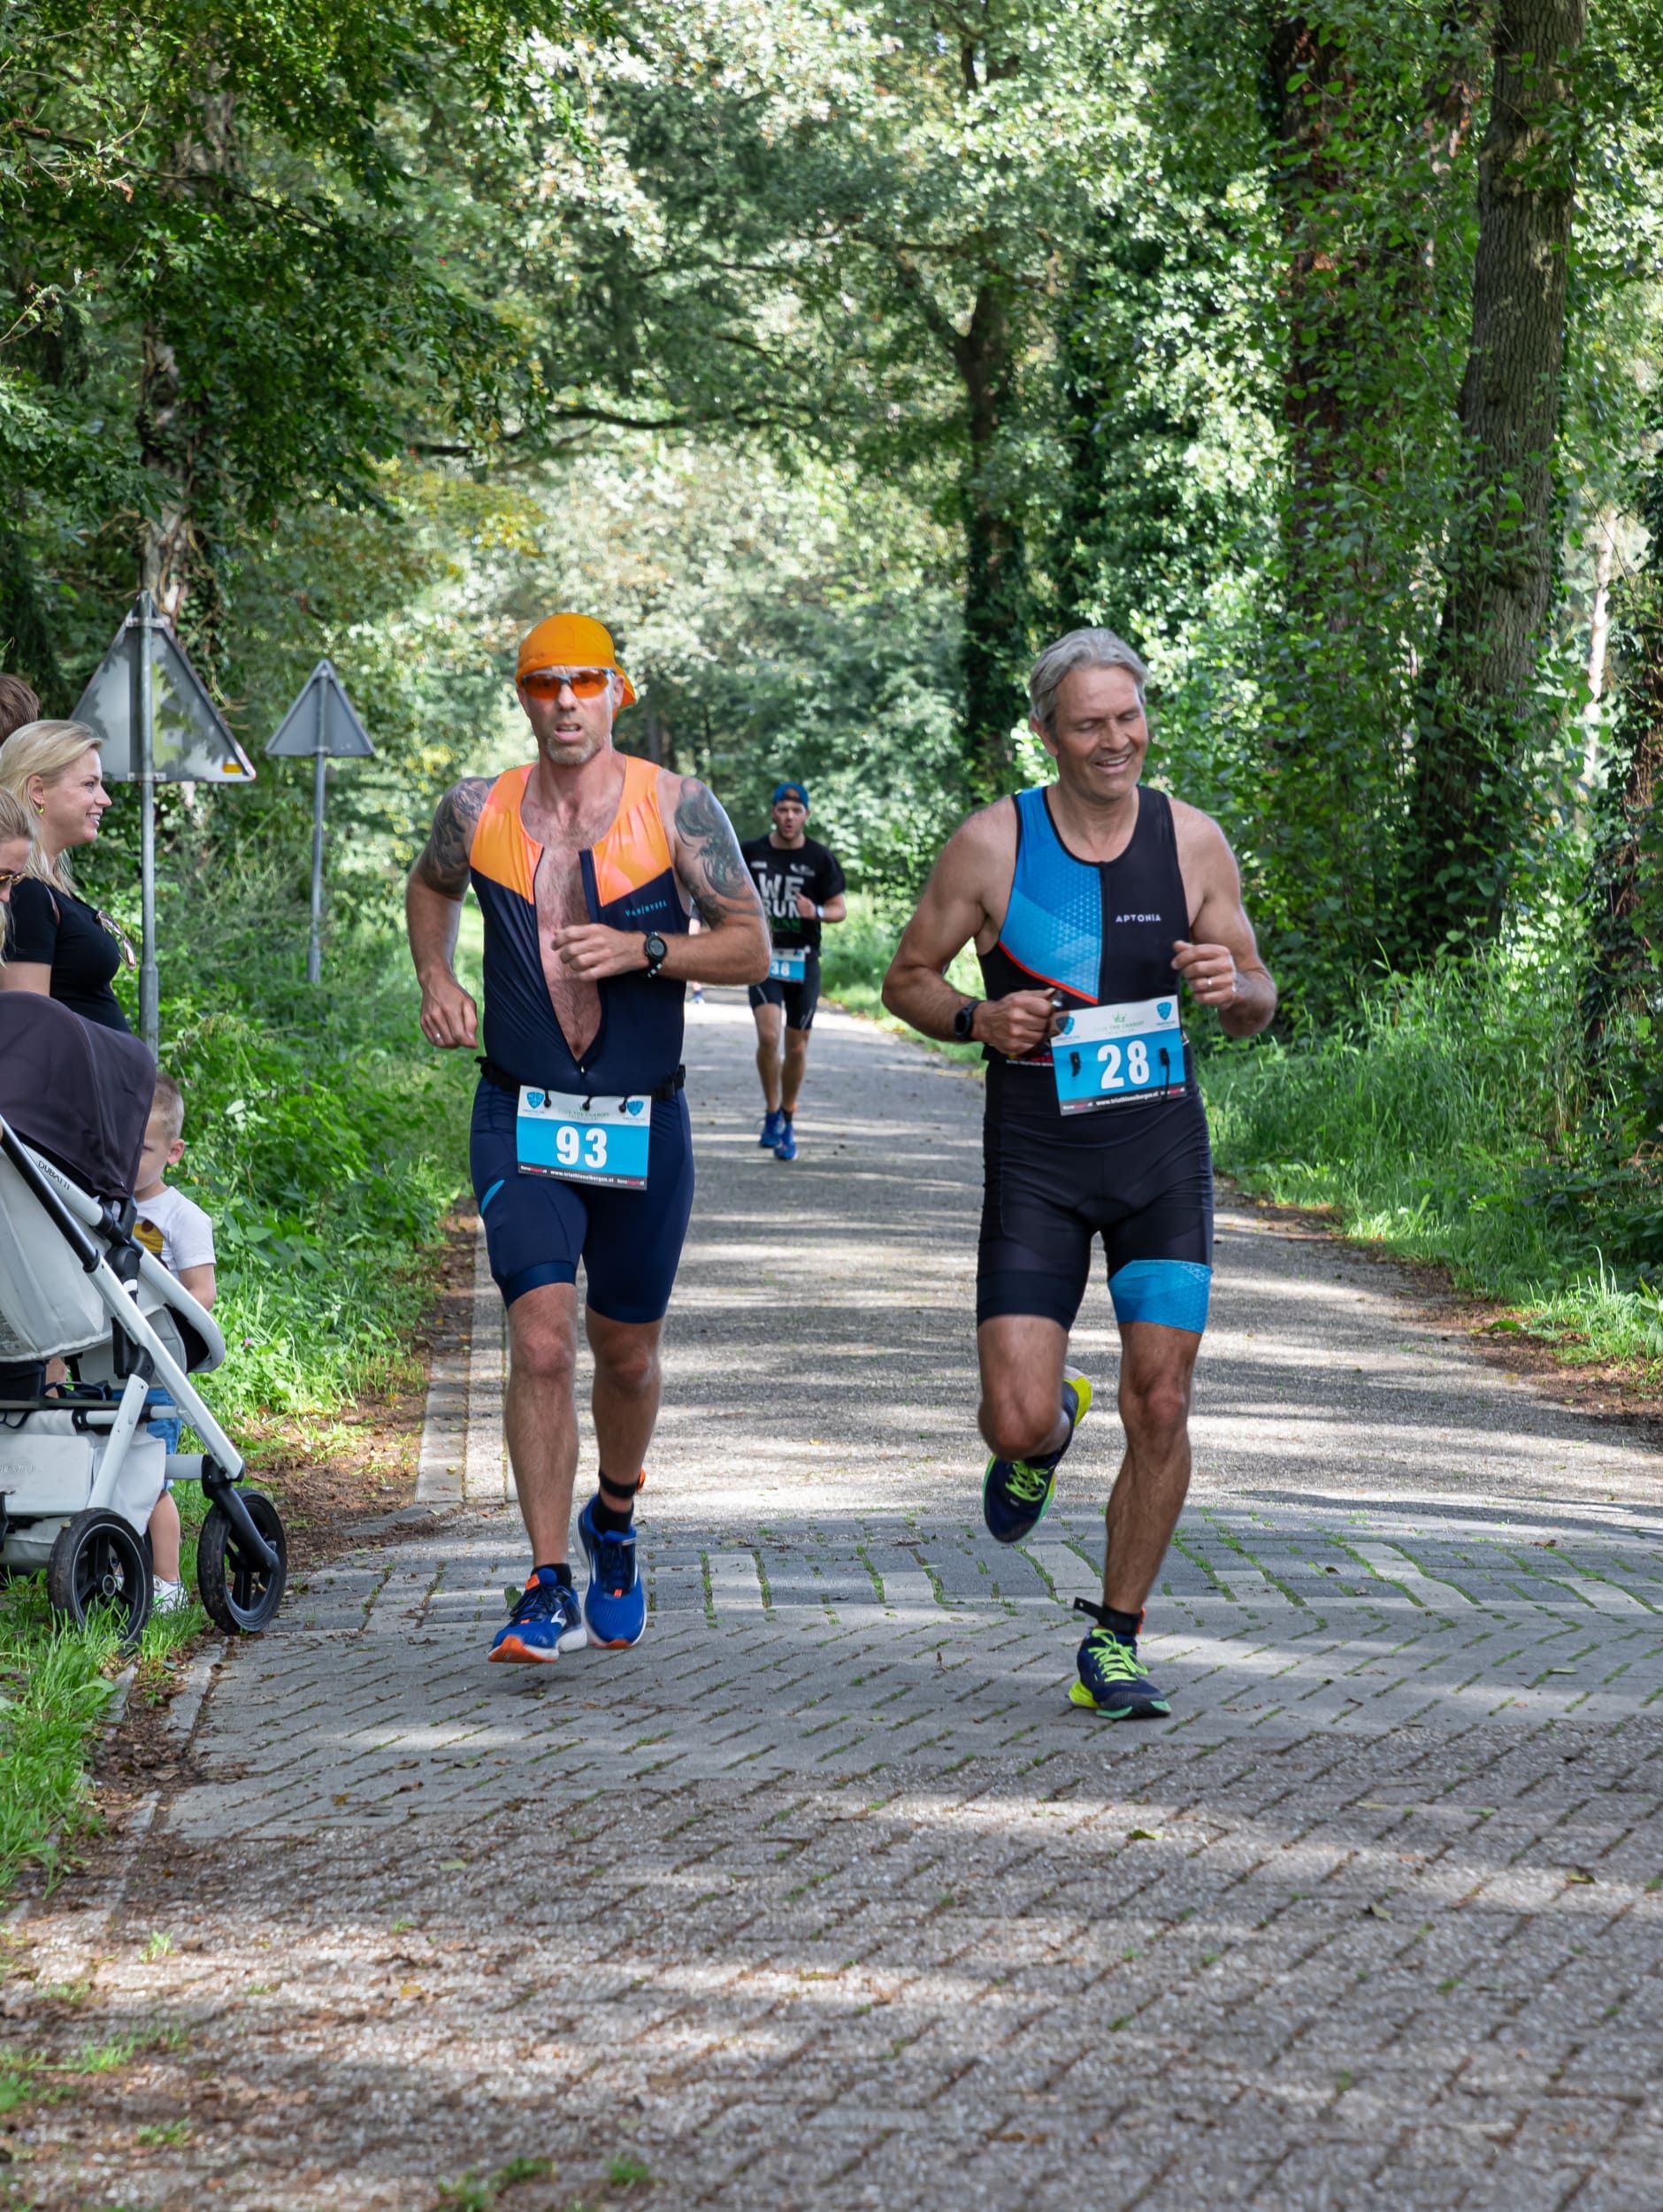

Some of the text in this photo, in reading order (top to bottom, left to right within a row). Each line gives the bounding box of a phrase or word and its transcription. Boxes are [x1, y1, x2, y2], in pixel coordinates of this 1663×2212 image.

[758, 872, 805, 900] WE
[1115, 914, 1161, 923] APTONIA
[1097, 1040, 1150, 1090] 28
[556, 1125, 608, 1169] 93
